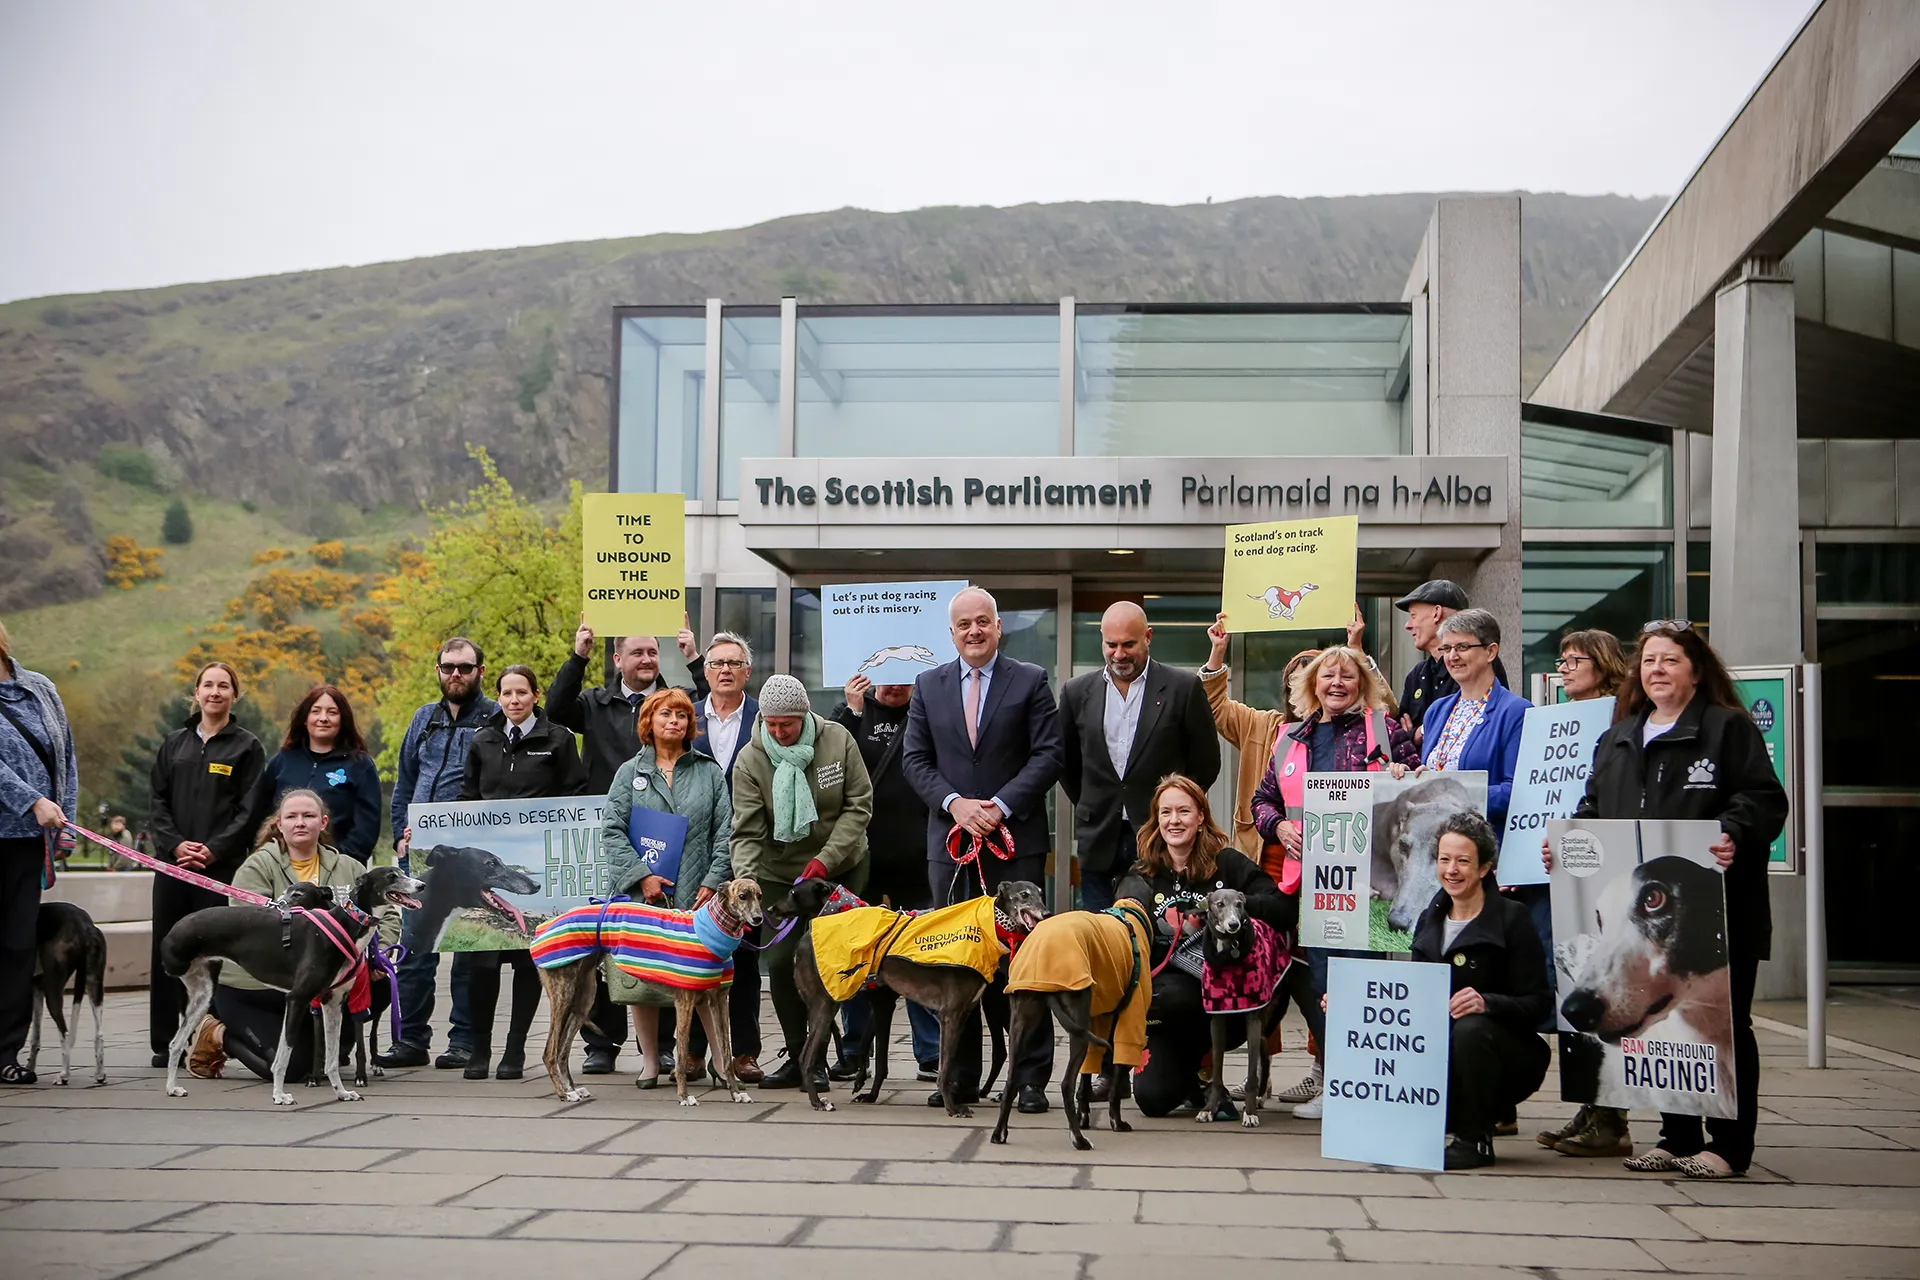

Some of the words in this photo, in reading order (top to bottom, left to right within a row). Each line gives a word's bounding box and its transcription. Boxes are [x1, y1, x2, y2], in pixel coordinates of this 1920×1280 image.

[755, 477, 816, 505] The
[824, 476, 953, 505] Scottish
[964, 475, 1151, 505] Parliament
[1181, 474, 1331, 505] Pàrlamaid
[1344, 483, 1380, 505] na
[1393, 475, 1491, 505] h-Alba
[616, 514, 652, 526] TIME
[624, 533, 644, 544] TO
[1234, 529, 1282, 543] Scotland's
[1284, 530, 1297, 539] on
[1299, 527, 1324, 538] track
[596, 552, 671, 563] UNBOUND
[1234, 548, 1244, 557] to
[1246, 546, 1264, 556] end
[1266, 545, 1284, 556] dog
[1286, 542, 1318, 554] racing.
[620, 570, 648, 582] THE
[588, 588, 680, 600] GREYHOUND
[832, 591, 858, 602] Let's
[860, 592, 879, 603] put
[881, 591, 901, 602] dog
[904, 590, 937, 601] racing
[832, 606, 851, 615] out
[853, 604, 865, 614] of
[867, 605, 880, 614] its
[883, 604, 922, 615] misery.
[1549, 720, 1580, 739] END
[1544, 742, 1578, 762] DOG
[1528, 764, 1587, 785] RACING
[1307, 779, 1370, 790] GREYHOUNDS
[1328, 791, 1347, 801] ARE
[1545, 788, 1562, 806] IN
[418, 811, 512, 830] GREYHOUNDS
[518, 808, 586, 824] DESERVE
[1304, 811, 1368, 854] PETS
[1562, 836, 1588, 845] Scotland
[544, 827, 607, 865] LIVE
[545, 864, 609, 898] FREE
[1315, 865, 1356, 890] NOT
[1314, 892, 1356, 912] BETS
[964, 926, 982, 936] THE
[920, 934, 981, 952] GREYHOUND
[1366, 981, 1409, 1000] END
[1363, 1006, 1410, 1027] DOG
[1347, 1030, 1425, 1054] RACING
[1622, 1038, 1645, 1055] BAN
[1648, 1040, 1715, 1060] GREYHOUND
[1374, 1058, 1395, 1076] IN
[1624, 1056, 1716, 1094] RACING!
[1329, 1079, 1440, 1106] SCOTLAND
